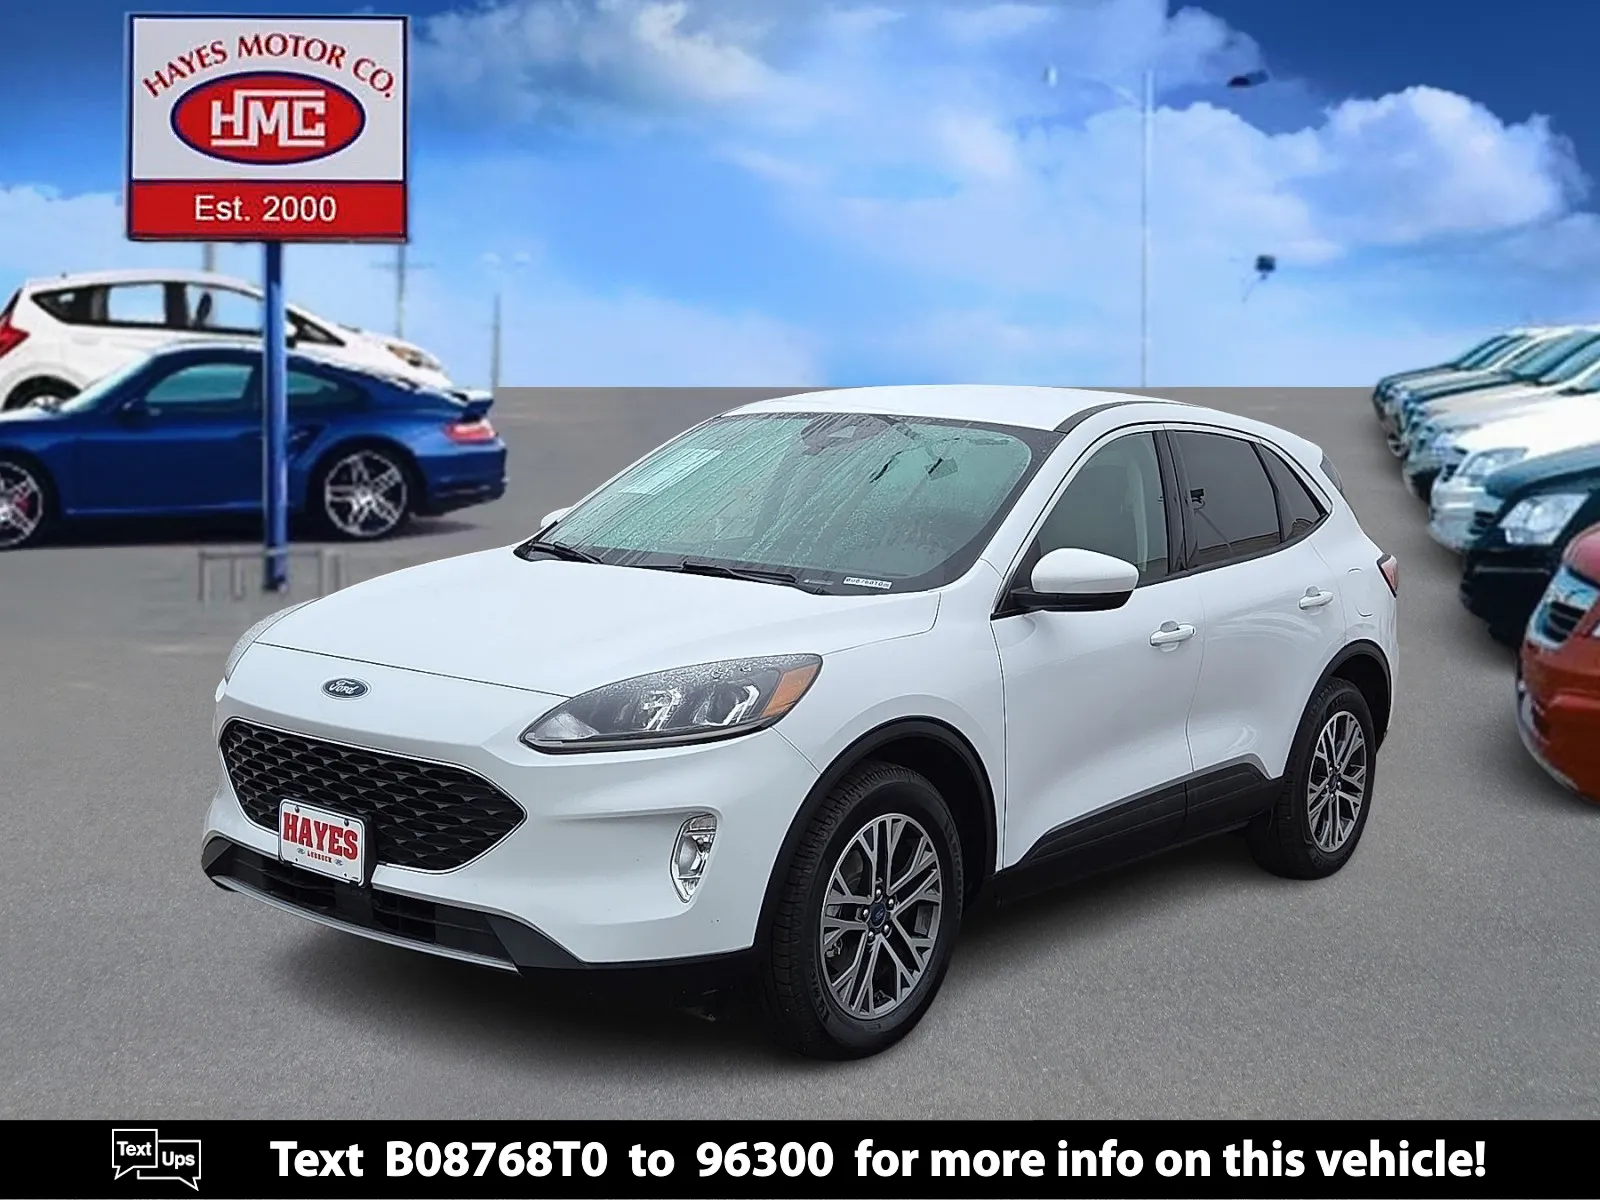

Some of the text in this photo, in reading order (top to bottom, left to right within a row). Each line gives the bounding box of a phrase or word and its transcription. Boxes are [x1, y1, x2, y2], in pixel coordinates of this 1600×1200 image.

[142, 32, 395, 99] HAYES MOTOR CO.
[210, 89, 326, 147] HMC
[194, 194, 337, 222] Est. 2000
[328, 679, 360, 695] Ford
[283, 811, 358, 860] HAYES
